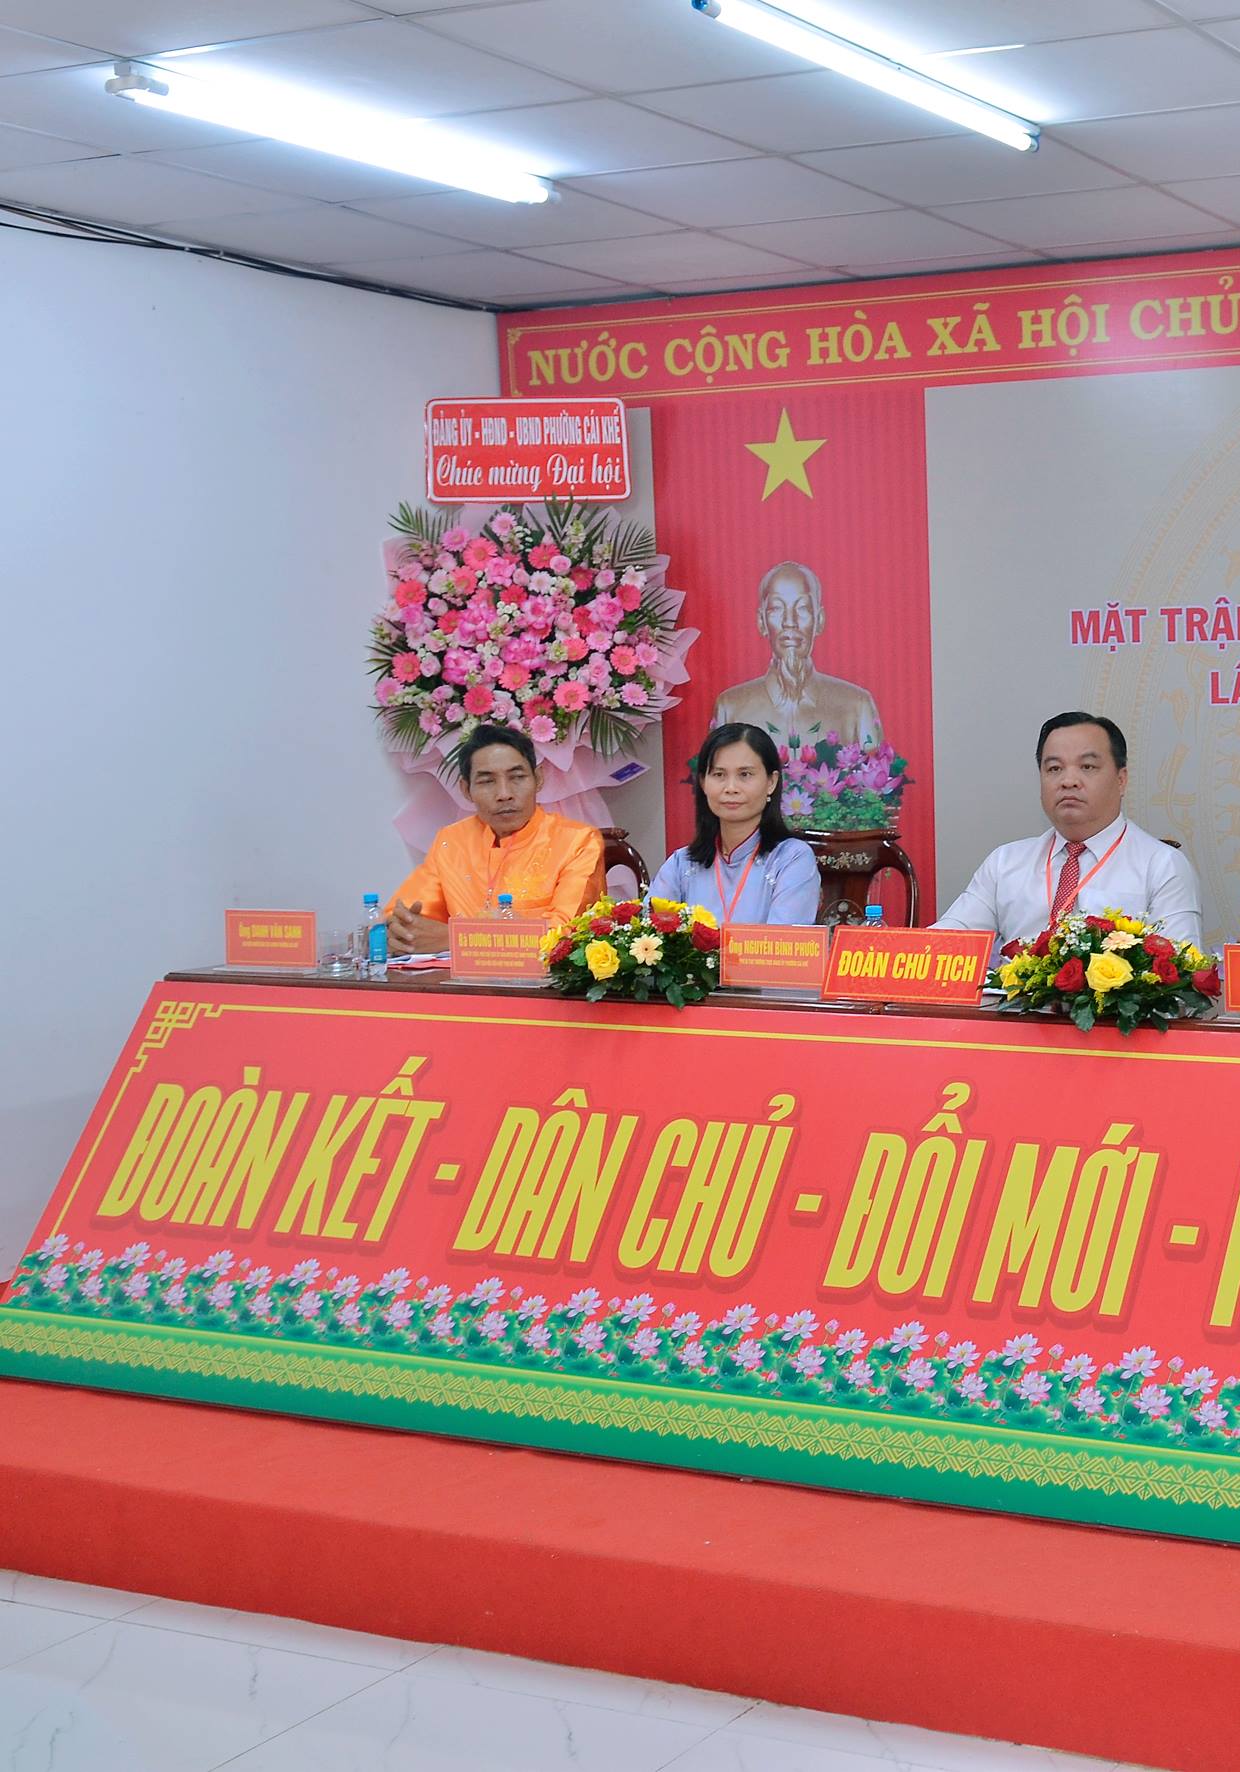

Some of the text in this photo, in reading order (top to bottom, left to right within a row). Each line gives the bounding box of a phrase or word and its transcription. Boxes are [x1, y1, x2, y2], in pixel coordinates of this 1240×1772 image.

[529, 338, 648, 388] NƯỚC
[664, 325, 790, 385] CỘNG
[807, 309, 910, 366] HÒA
[926, 301, 1001, 356] XÃ
[1018, 292, 1110, 357] HỘI
[431, 410, 458, 447] ĐẢNG
[459, 409, 473, 447] ỦY
[481, 416, 508, 446] HĐND
[515, 415, 542, 446] UBND
[543, 409, 582, 445] PHƯỜNG
[583, 409, 601, 445] CÁI
[602, 405, 621, 445] KHẾ
[436, 453, 622, 492] Chúc mừng Đại hội
[1070, 602, 1148, 653] MẶT
[837, 945, 978, 988] ĐOÀN CHỦ TỊCH
[95, 1065, 309, 1231] ĐOÀN
[274, 1055, 446, 1243] KẾT
[435, 1162, 461, 1181] -
[452, 1087, 639, 1264] DÂN
[617, 1093, 797, 1279] CHỦ
[795, 1193, 823, 1213] -
[822, 1081, 988, 1299] ĐỔI
[972, 1122, 1161, 1317] MỚI
[1169, 1224, 1200, 1246] -
